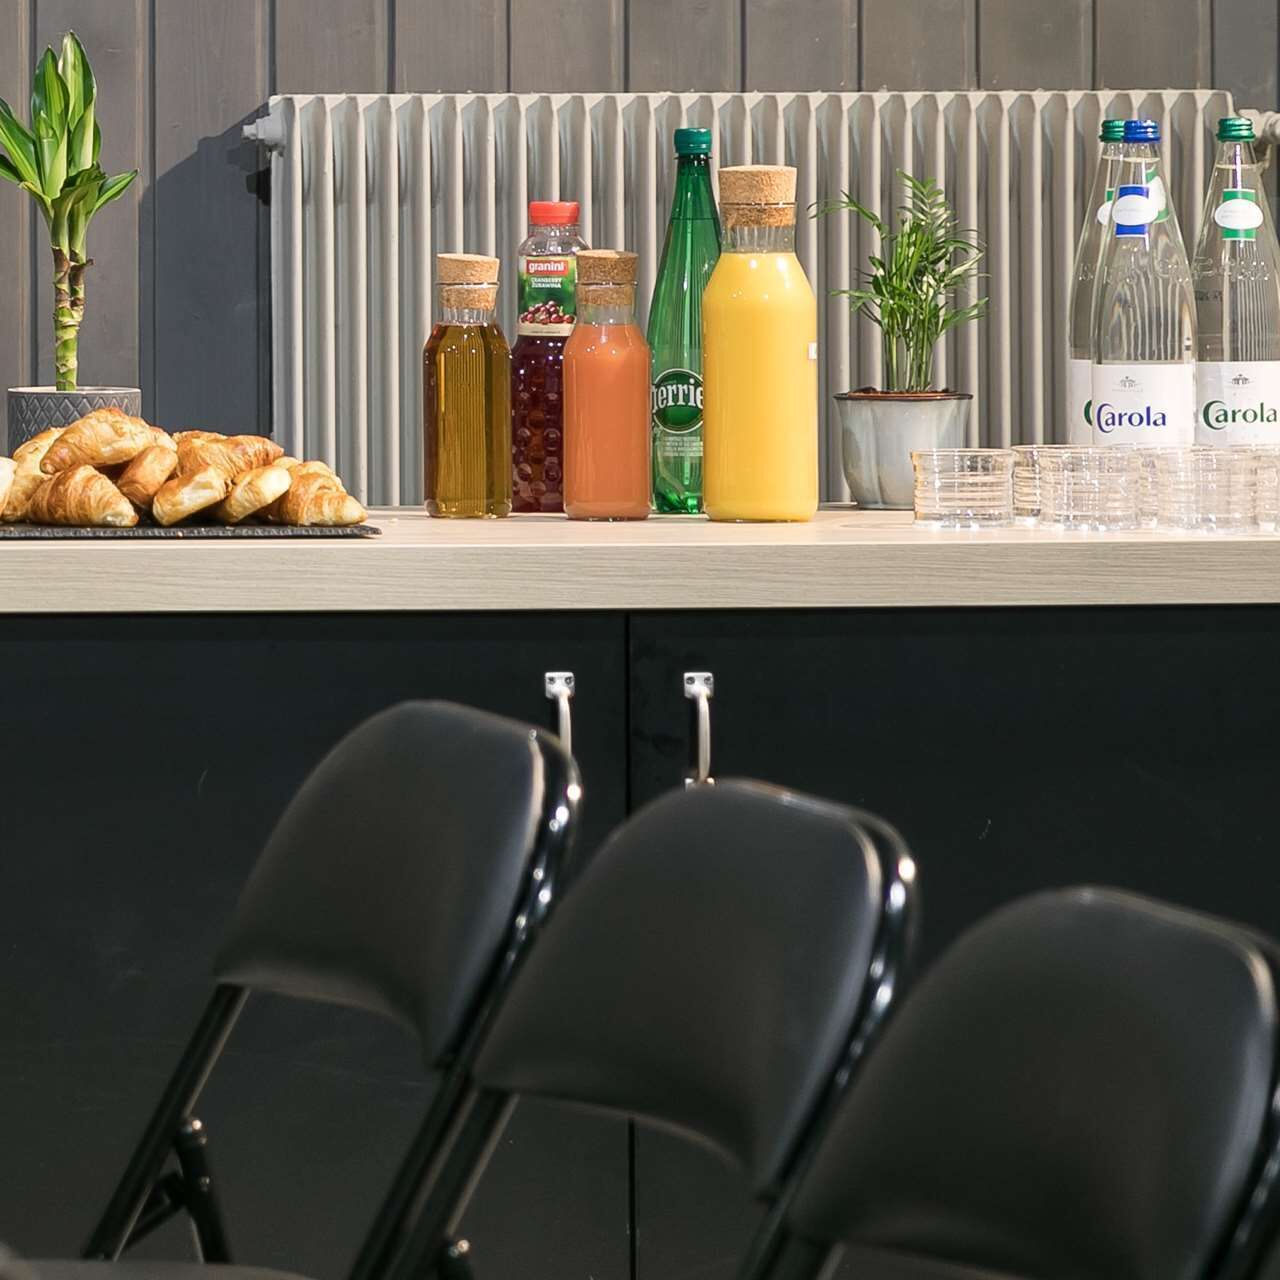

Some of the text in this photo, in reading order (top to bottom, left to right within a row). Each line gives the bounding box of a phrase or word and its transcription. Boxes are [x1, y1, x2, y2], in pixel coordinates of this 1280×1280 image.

[528, 261, 565, 273] granini
[1096, 403, 1166, 434] Carola
[1202, 400, 1278, 430] Carola
